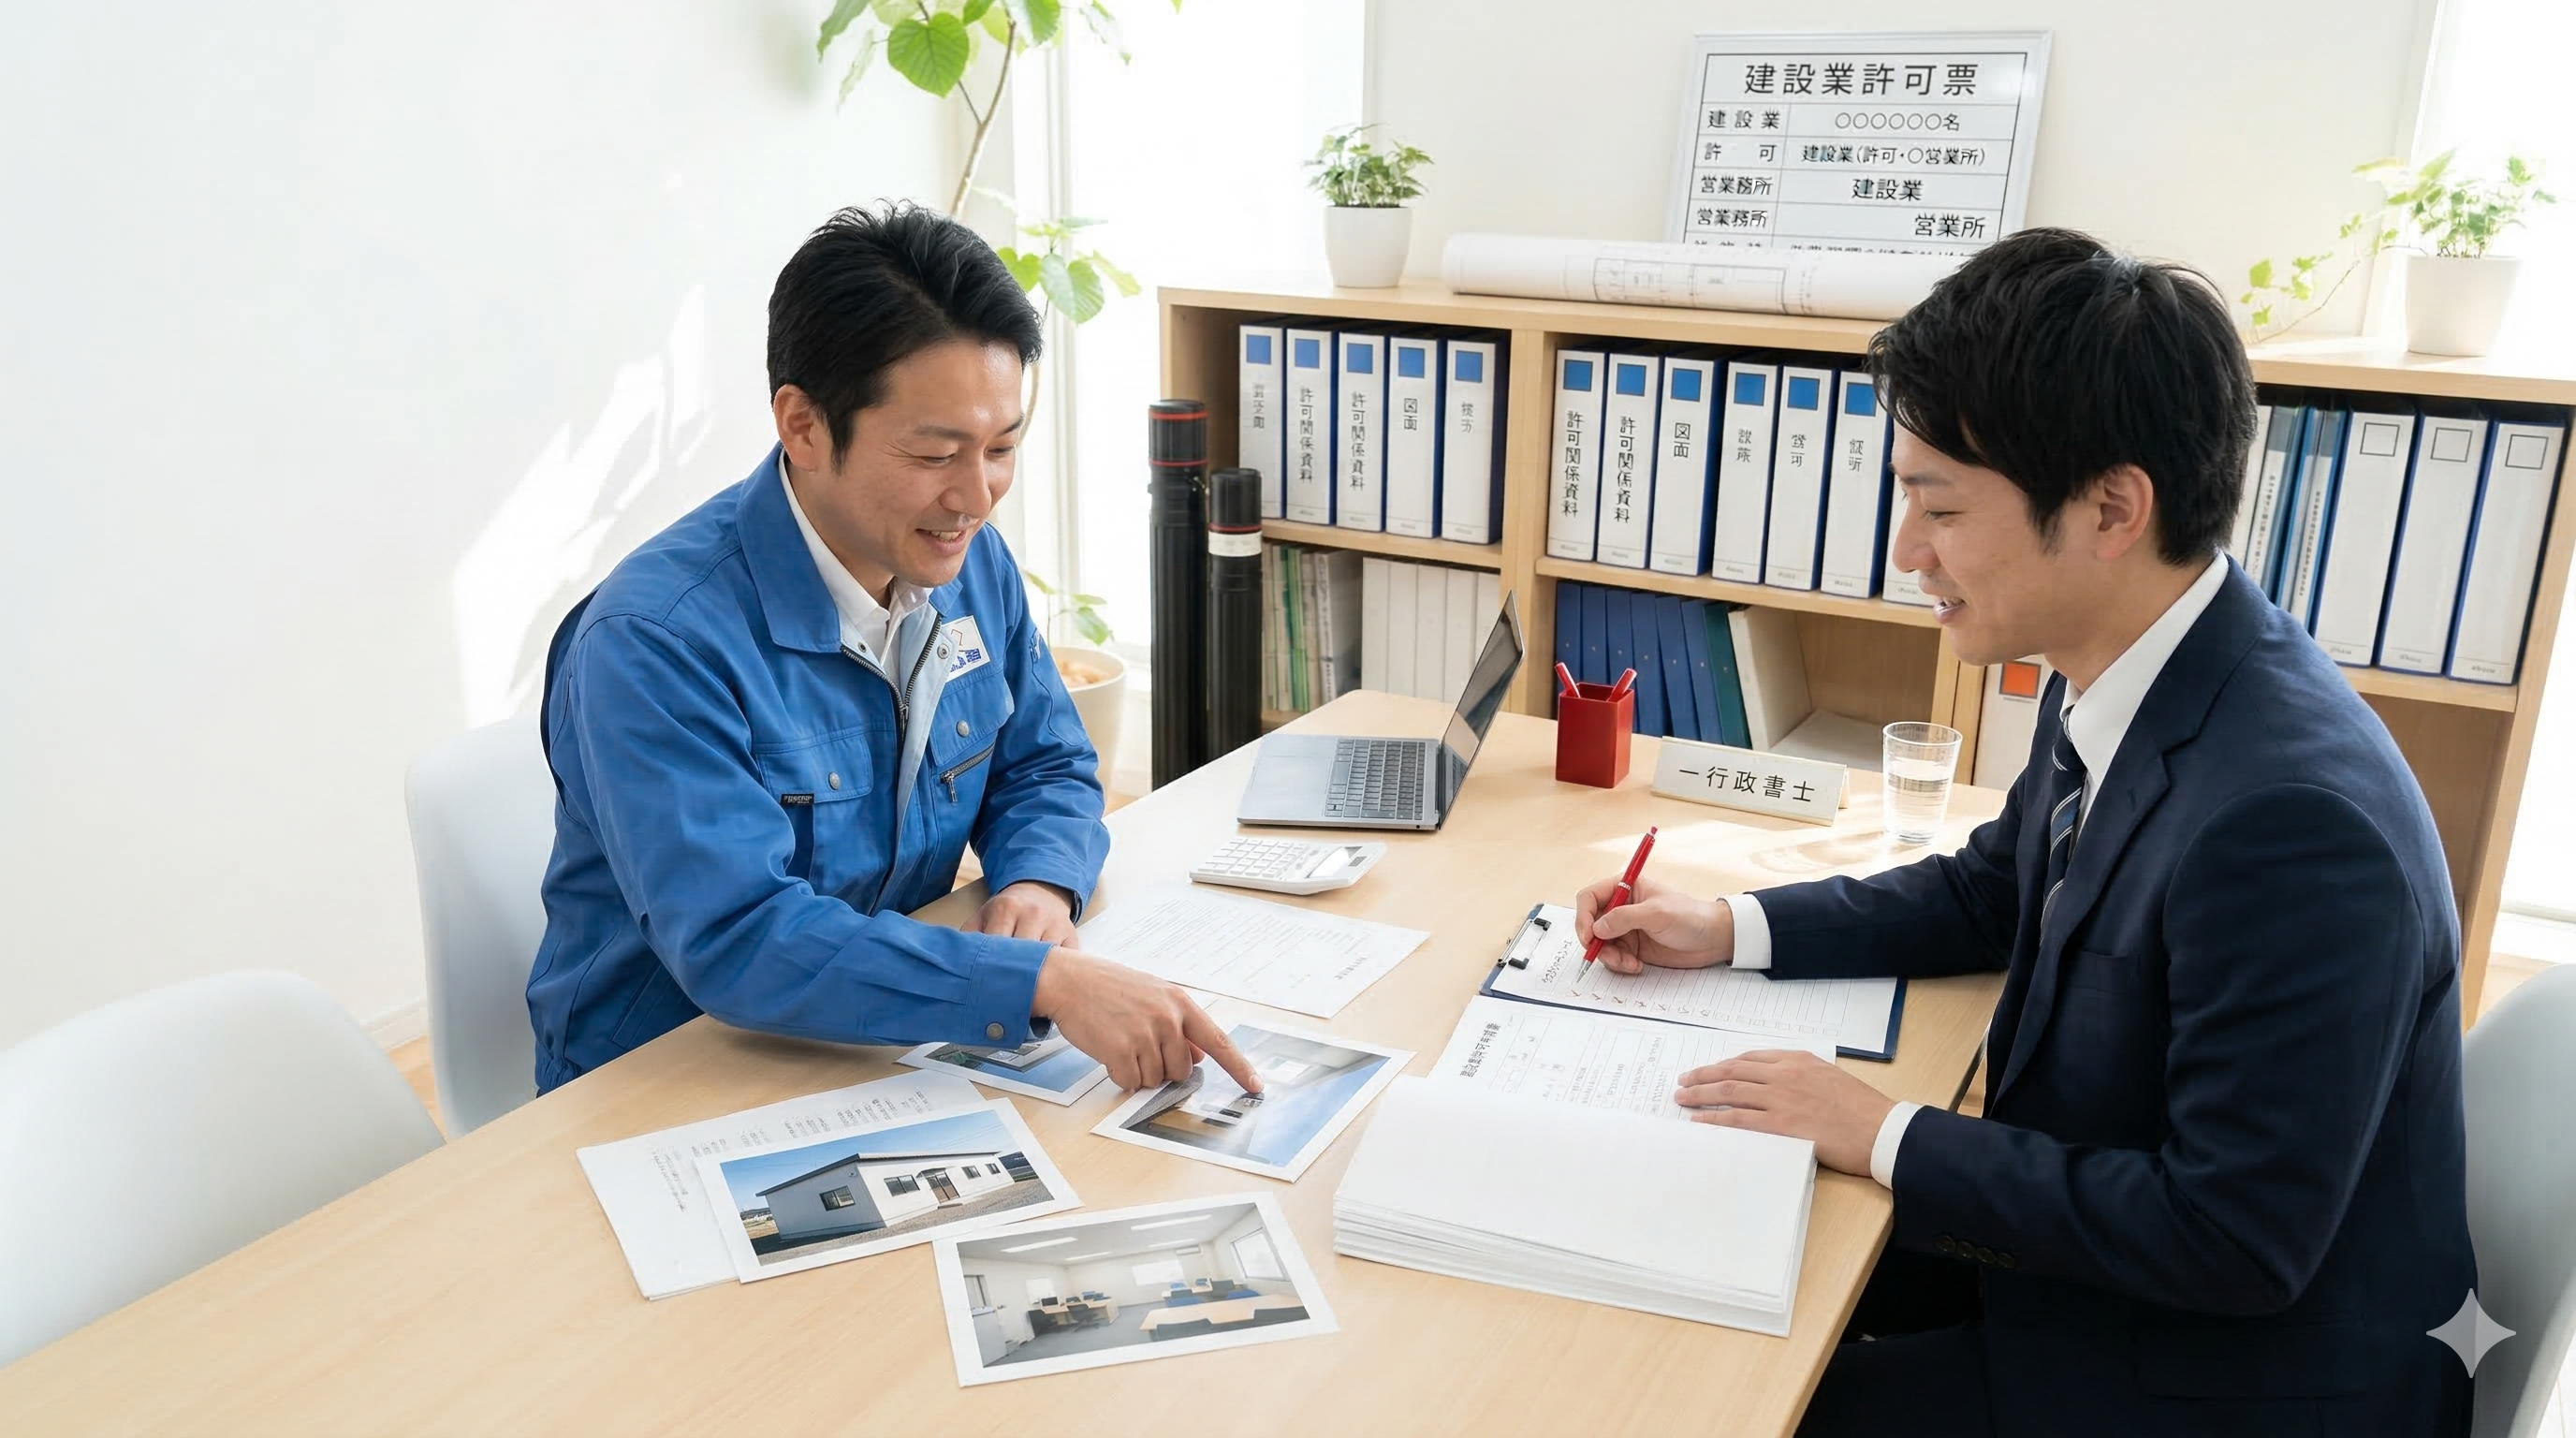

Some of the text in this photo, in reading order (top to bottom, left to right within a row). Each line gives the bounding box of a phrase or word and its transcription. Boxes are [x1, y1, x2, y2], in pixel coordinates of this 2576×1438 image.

[1744, 62, 1979, 96] 建設業許可票
[1707, 110, 1780, 129] 建設業
[1852, 178, 1924, 201] 建設業
[1914, 212, 1986, 239] 営業所
[1673, 422, 1690, 459] 図面
[1678, 766, 1815, 802] 一行政書士
